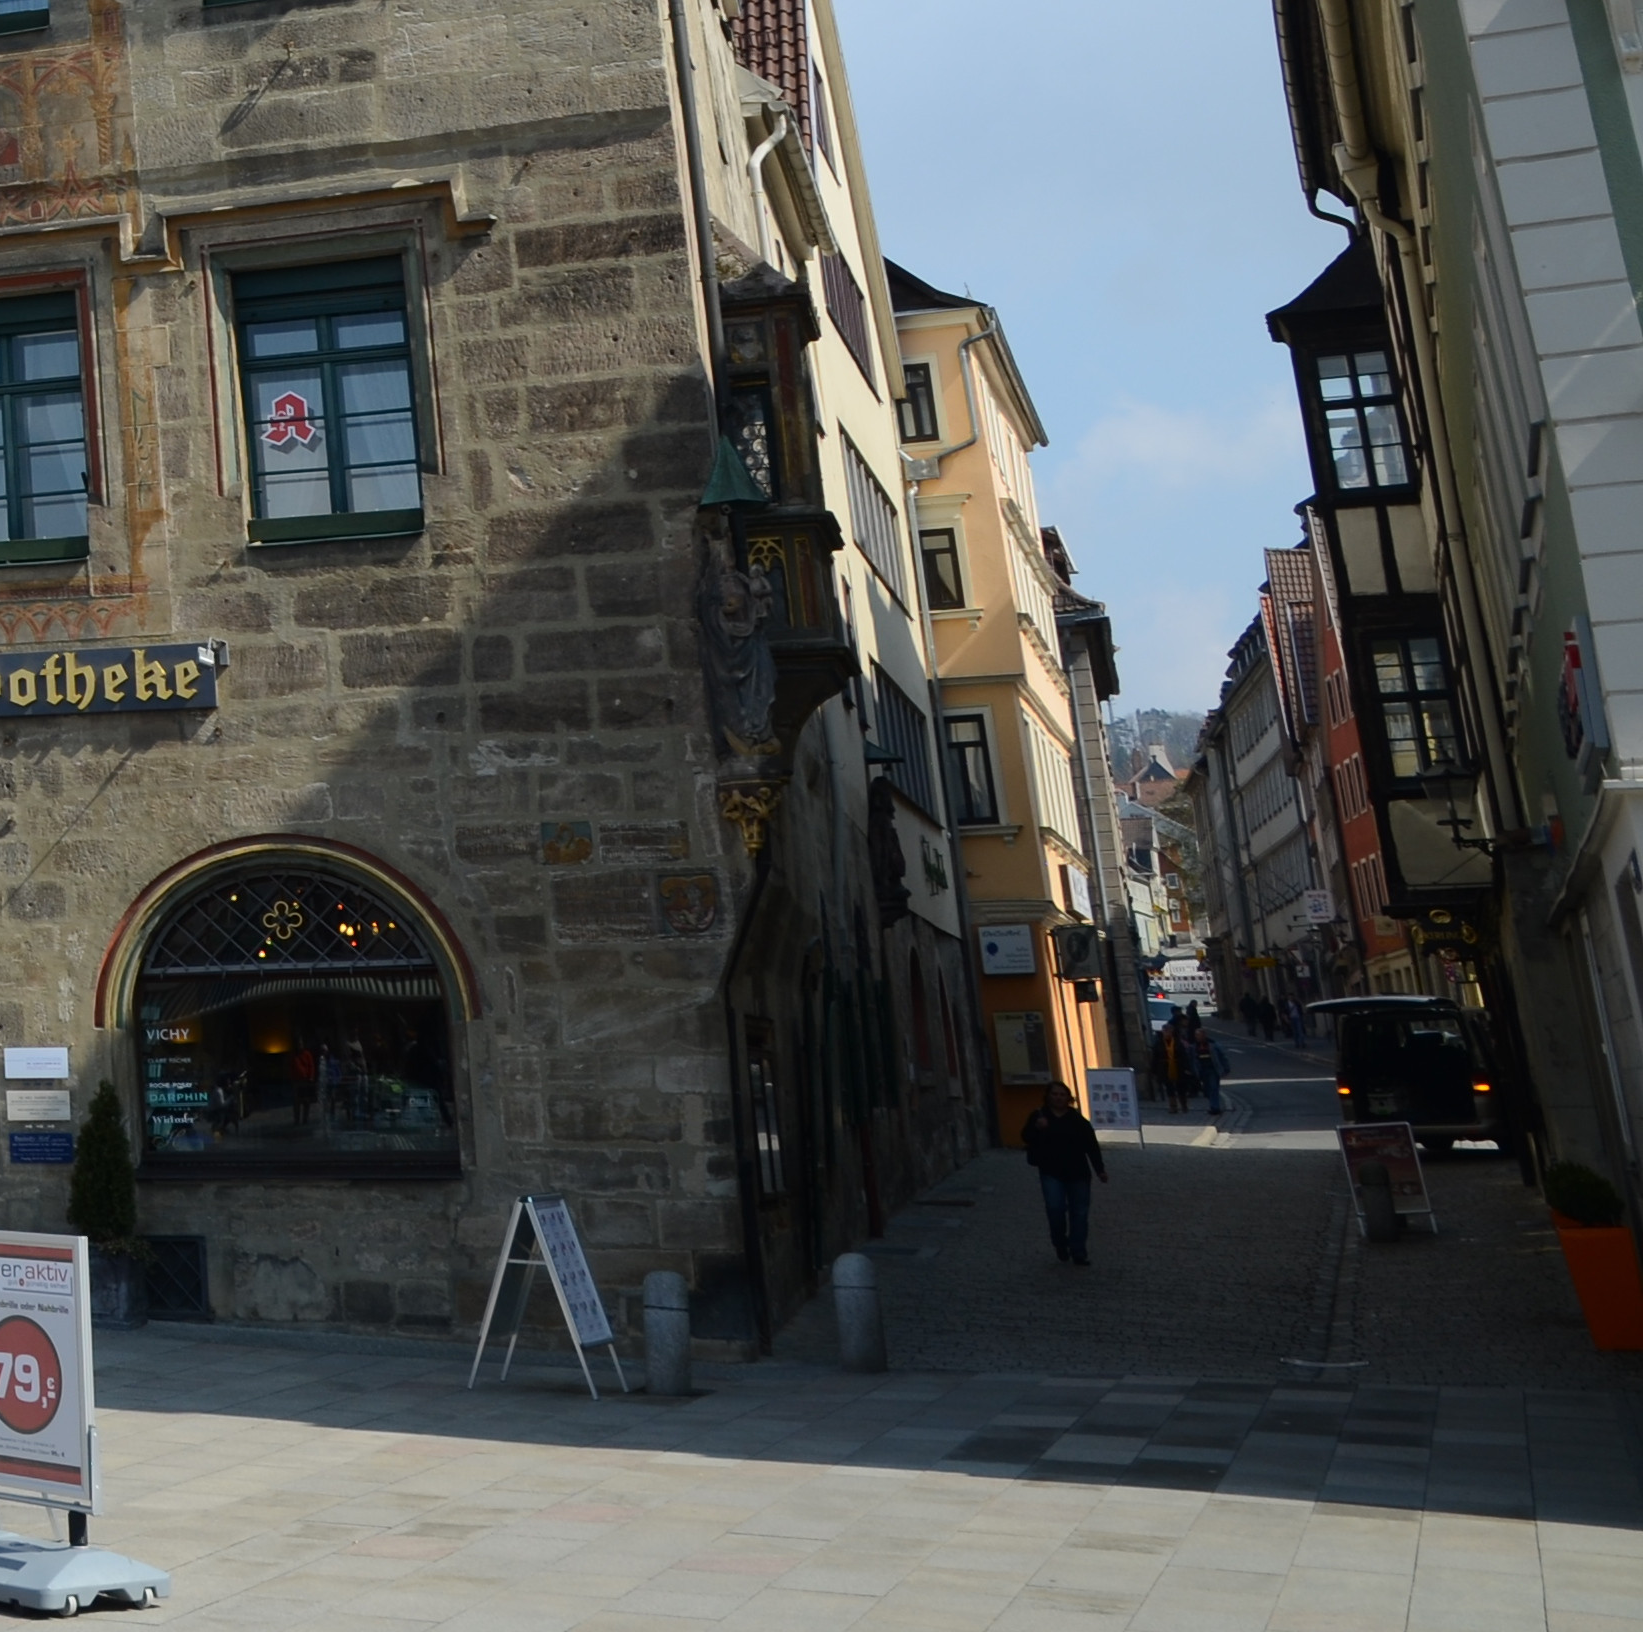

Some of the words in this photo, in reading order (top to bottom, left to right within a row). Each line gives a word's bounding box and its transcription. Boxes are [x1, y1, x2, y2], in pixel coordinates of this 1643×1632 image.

[146, 1028, 190, 1041] VICHY
[148, 1092, 208, 1102] DARPHIN
[25, 1263, 68, 1282] aktiv
